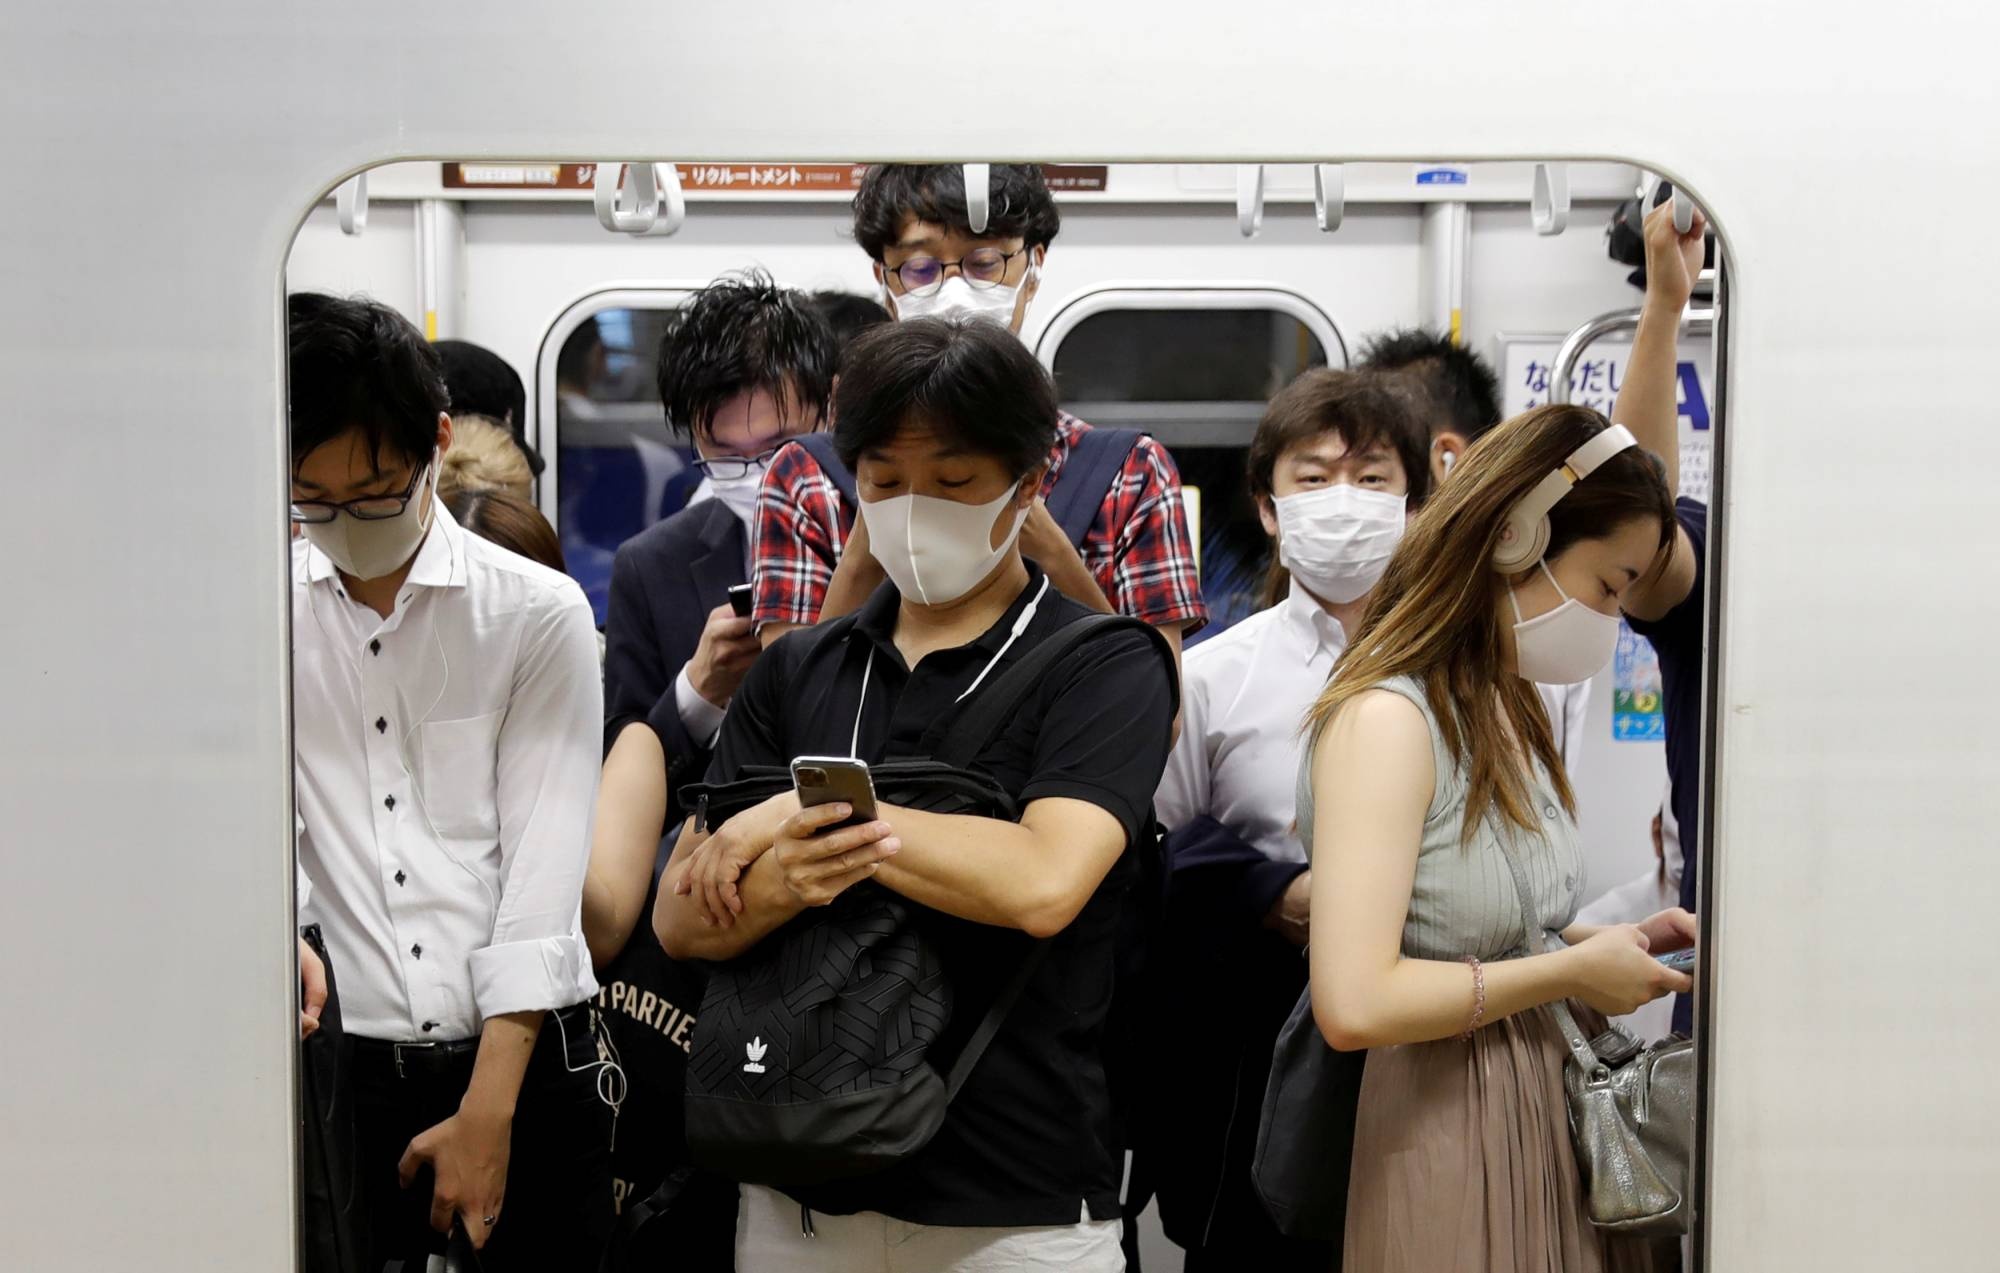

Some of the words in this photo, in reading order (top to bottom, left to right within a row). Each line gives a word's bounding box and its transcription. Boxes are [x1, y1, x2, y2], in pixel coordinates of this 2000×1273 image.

[691, 166, 801, 186] リクルートメント
